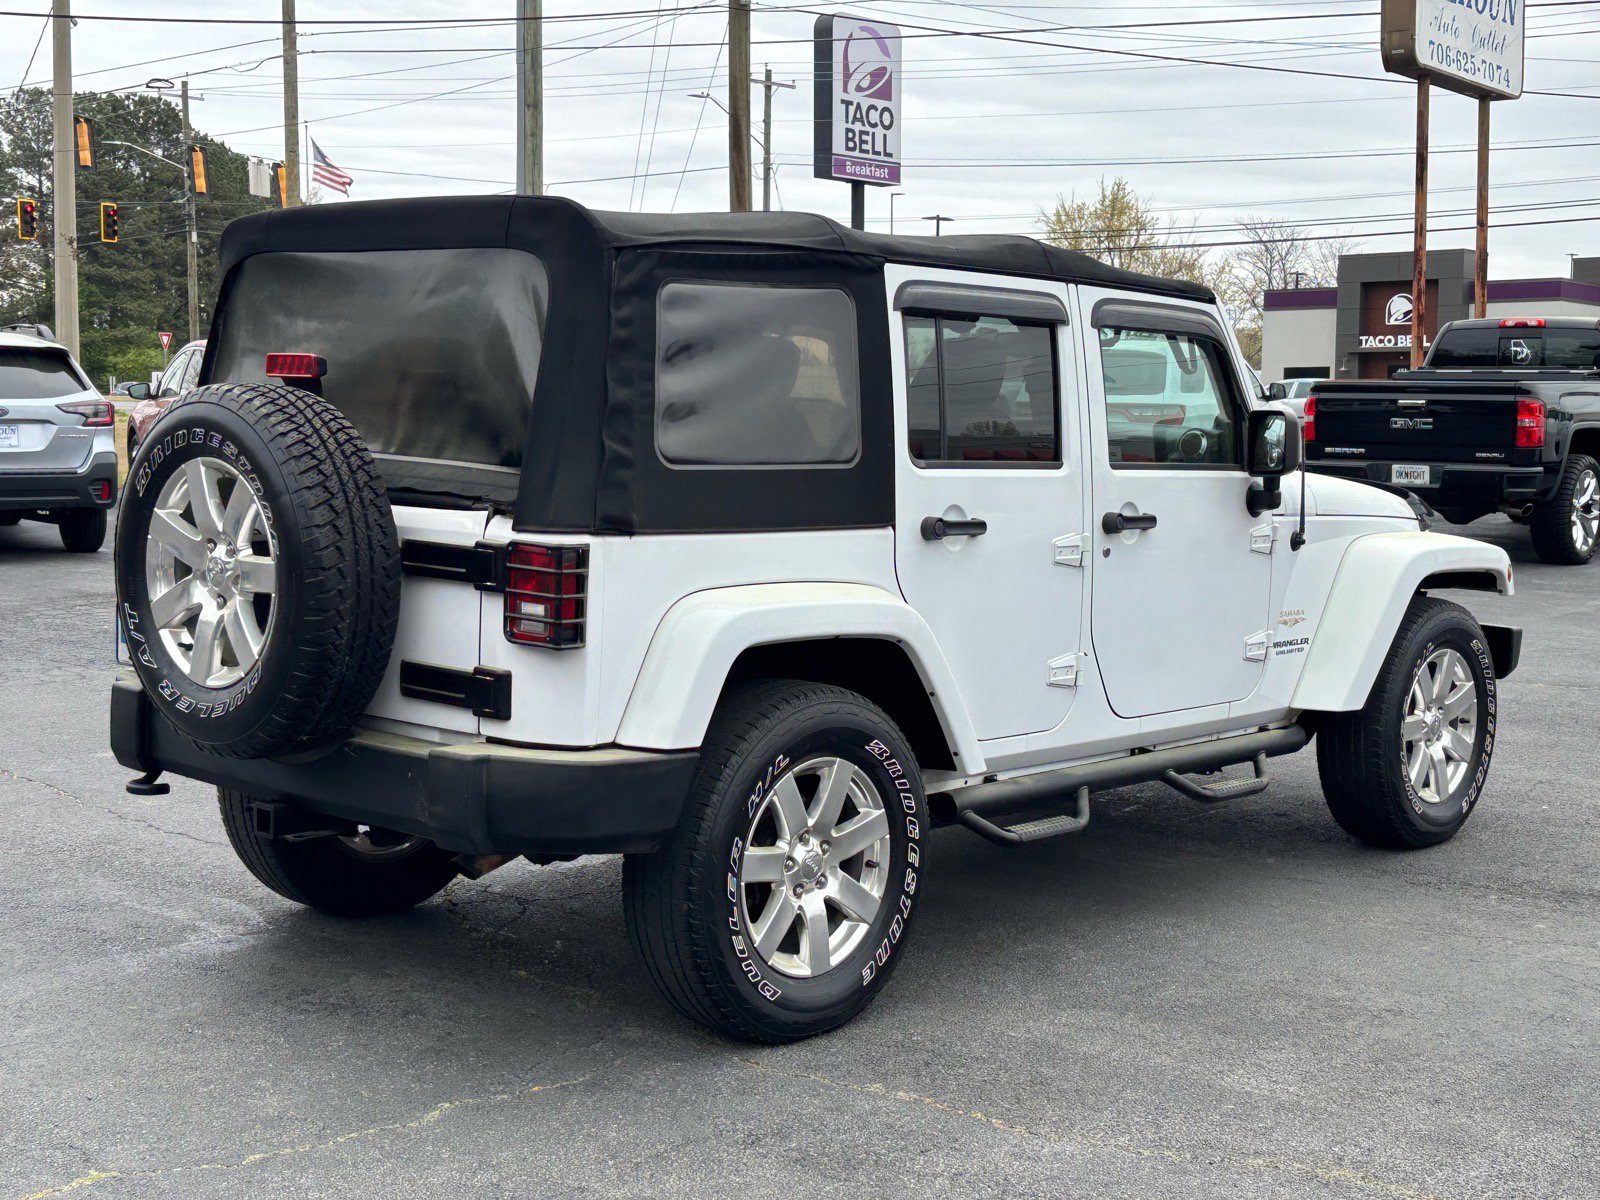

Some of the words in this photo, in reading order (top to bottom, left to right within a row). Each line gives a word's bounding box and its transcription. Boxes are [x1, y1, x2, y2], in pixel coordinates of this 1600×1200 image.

[1429, 7, 1460, 39] Auto
[1472, 22, 1507, 55] Outlet
[840, 99, 894, 131] TACO
[844, 127, 893, 158] BELL
[846, 162, 889, 179] Breakfast
[1359, 335, 1395, 347] TACO
[1397, 335, 1430, 347] BEL
[1390, 417, 1433, 429] GMC
[124, 602, 158, 669] A/T
[1272, 637, 1310, 648] WRANGLER
[1275, 647, 1305, 656] UNLIMITED
[158, 660, 262, 718] DUELER
[862, 739, 920, 986] BRIDGESTONE
[727, 836, 781, 1001] DUELER
